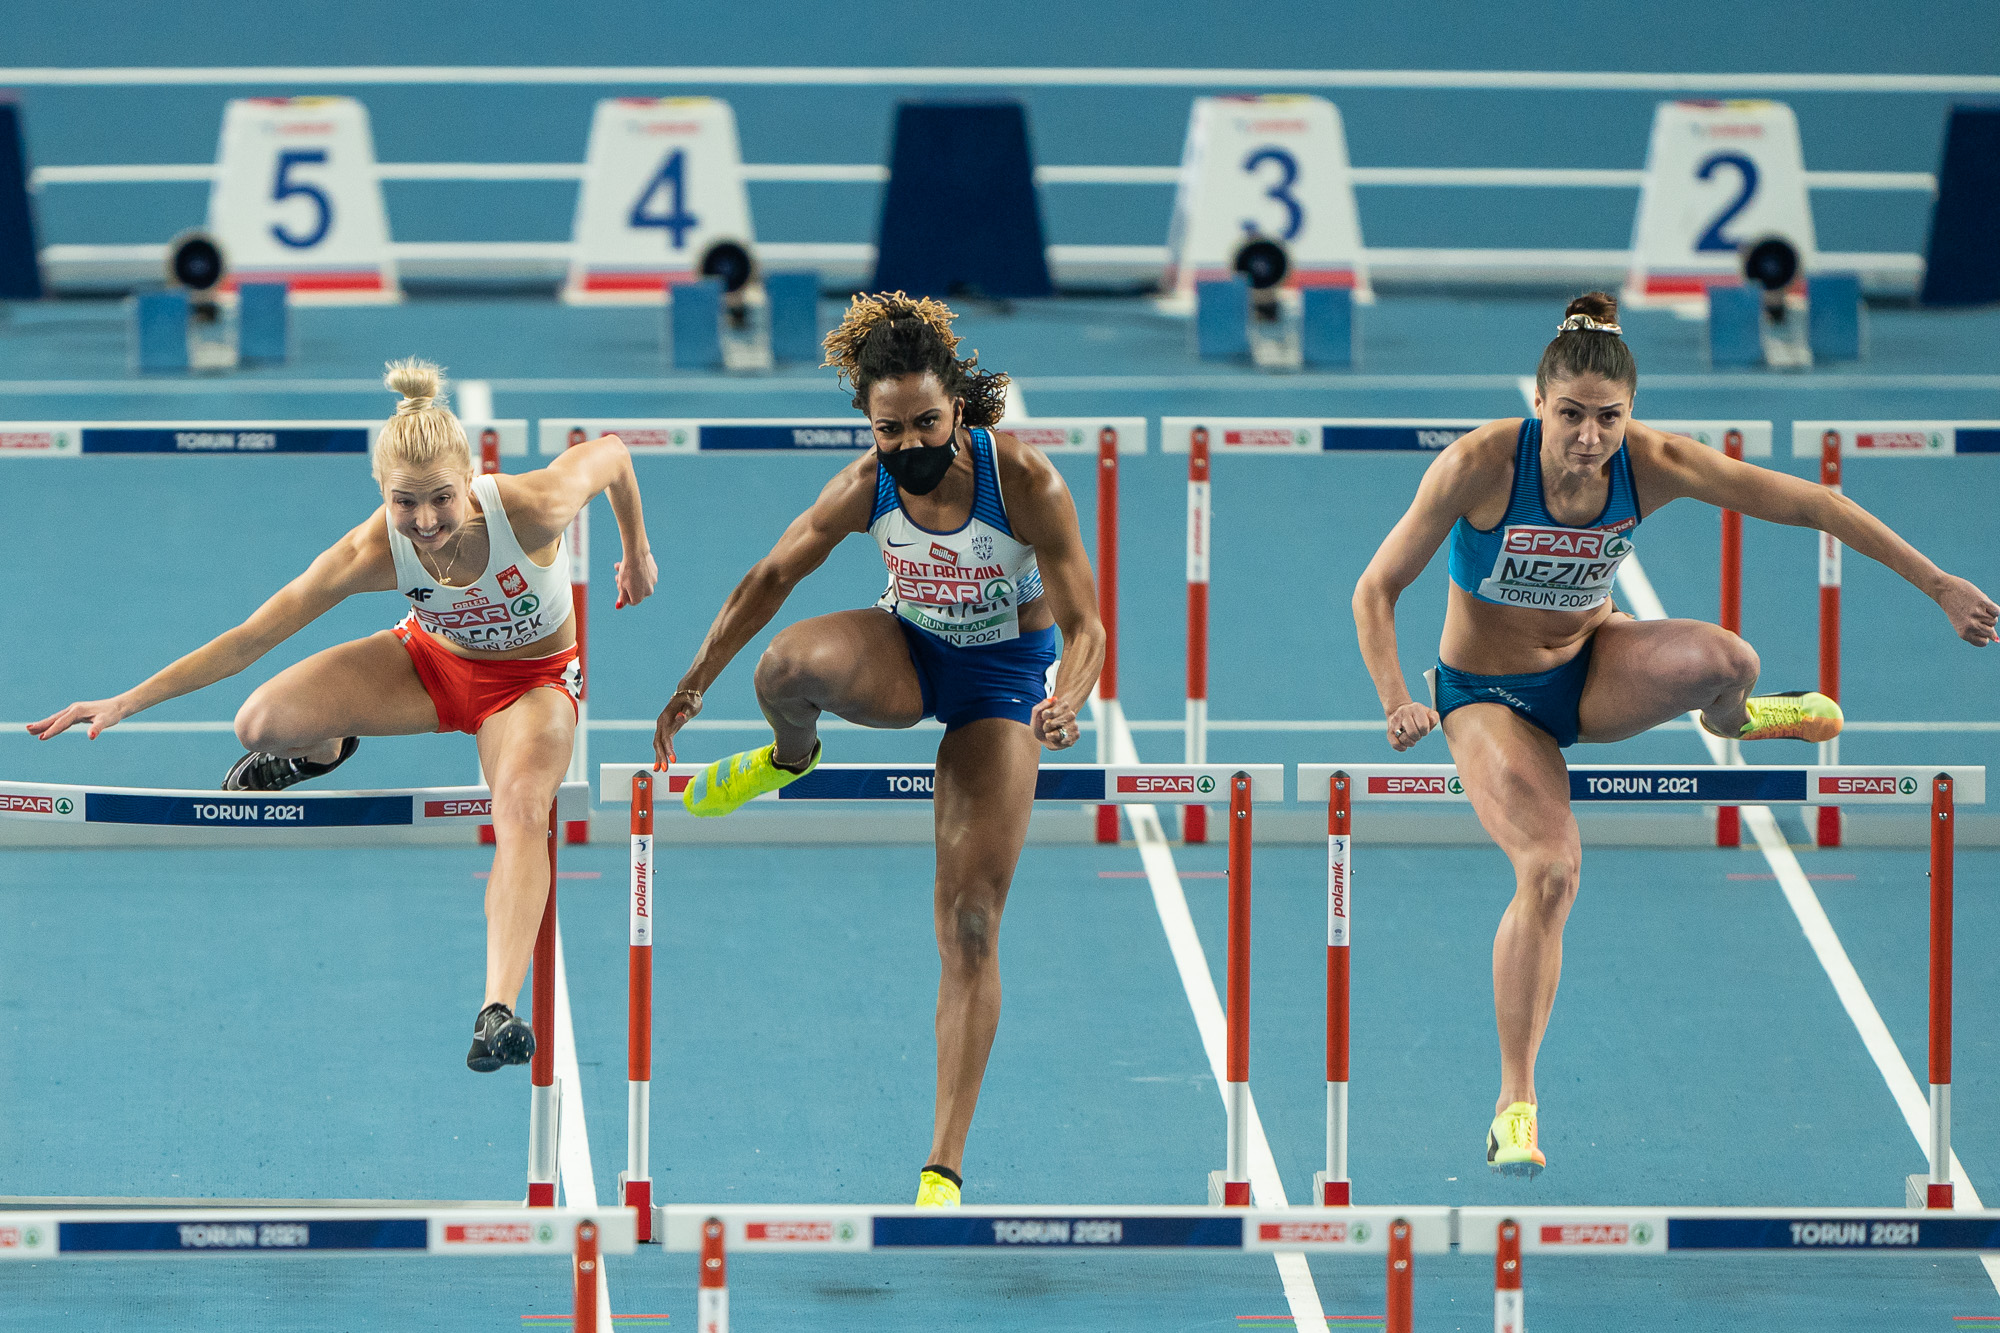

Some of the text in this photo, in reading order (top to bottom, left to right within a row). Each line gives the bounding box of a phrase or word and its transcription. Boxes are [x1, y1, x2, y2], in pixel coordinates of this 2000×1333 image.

[271, 148, 333, 250] 5
[628, 147, 699, 250] 4
[1241, 145, 1304, 241] 3
[1694, 153, 1759, 251] 2
[175, 432, 277, 450] TORUN 2021
[1509, 532, 1600, 555] SPAR
[883, 550, 931, 577] GREAT
[931, 547, 956, 562] müller
[1500, 557, 1618, 585] NEZIRI
[899, 580, 979, 604] SPAR
[1500, 587, 1594, 607] TORUŃ 2021
[454, 598, 488, 609] ORLEN
[418, 607, 507, 626] SPAR
[916, 612, 987, 631] I RUN CLEAN
[504, 631, 539, 650] 2021
[966, 628, 1001, 646] 2021
[886, 776, 935, 793] TORU
[1136, 778, 1192, 791] SPAR
[1387, 779, 1443, 793] SPAR
[1587, 777, 1697, 793] TORUN 2021
[1837, 779, 1895, 792] SPAR
[193, 804, 304, 820] TORUN 2021
[634, 861, 648, 918] polanik
[1332, 861, 1345, 918] polanik
[177, 1224, 309, 1247] TORUN 2021
[992, 1221, 1122, 1243] TORUN 2021
[1789, 1222, 1920, 1245] TORUN 2021
